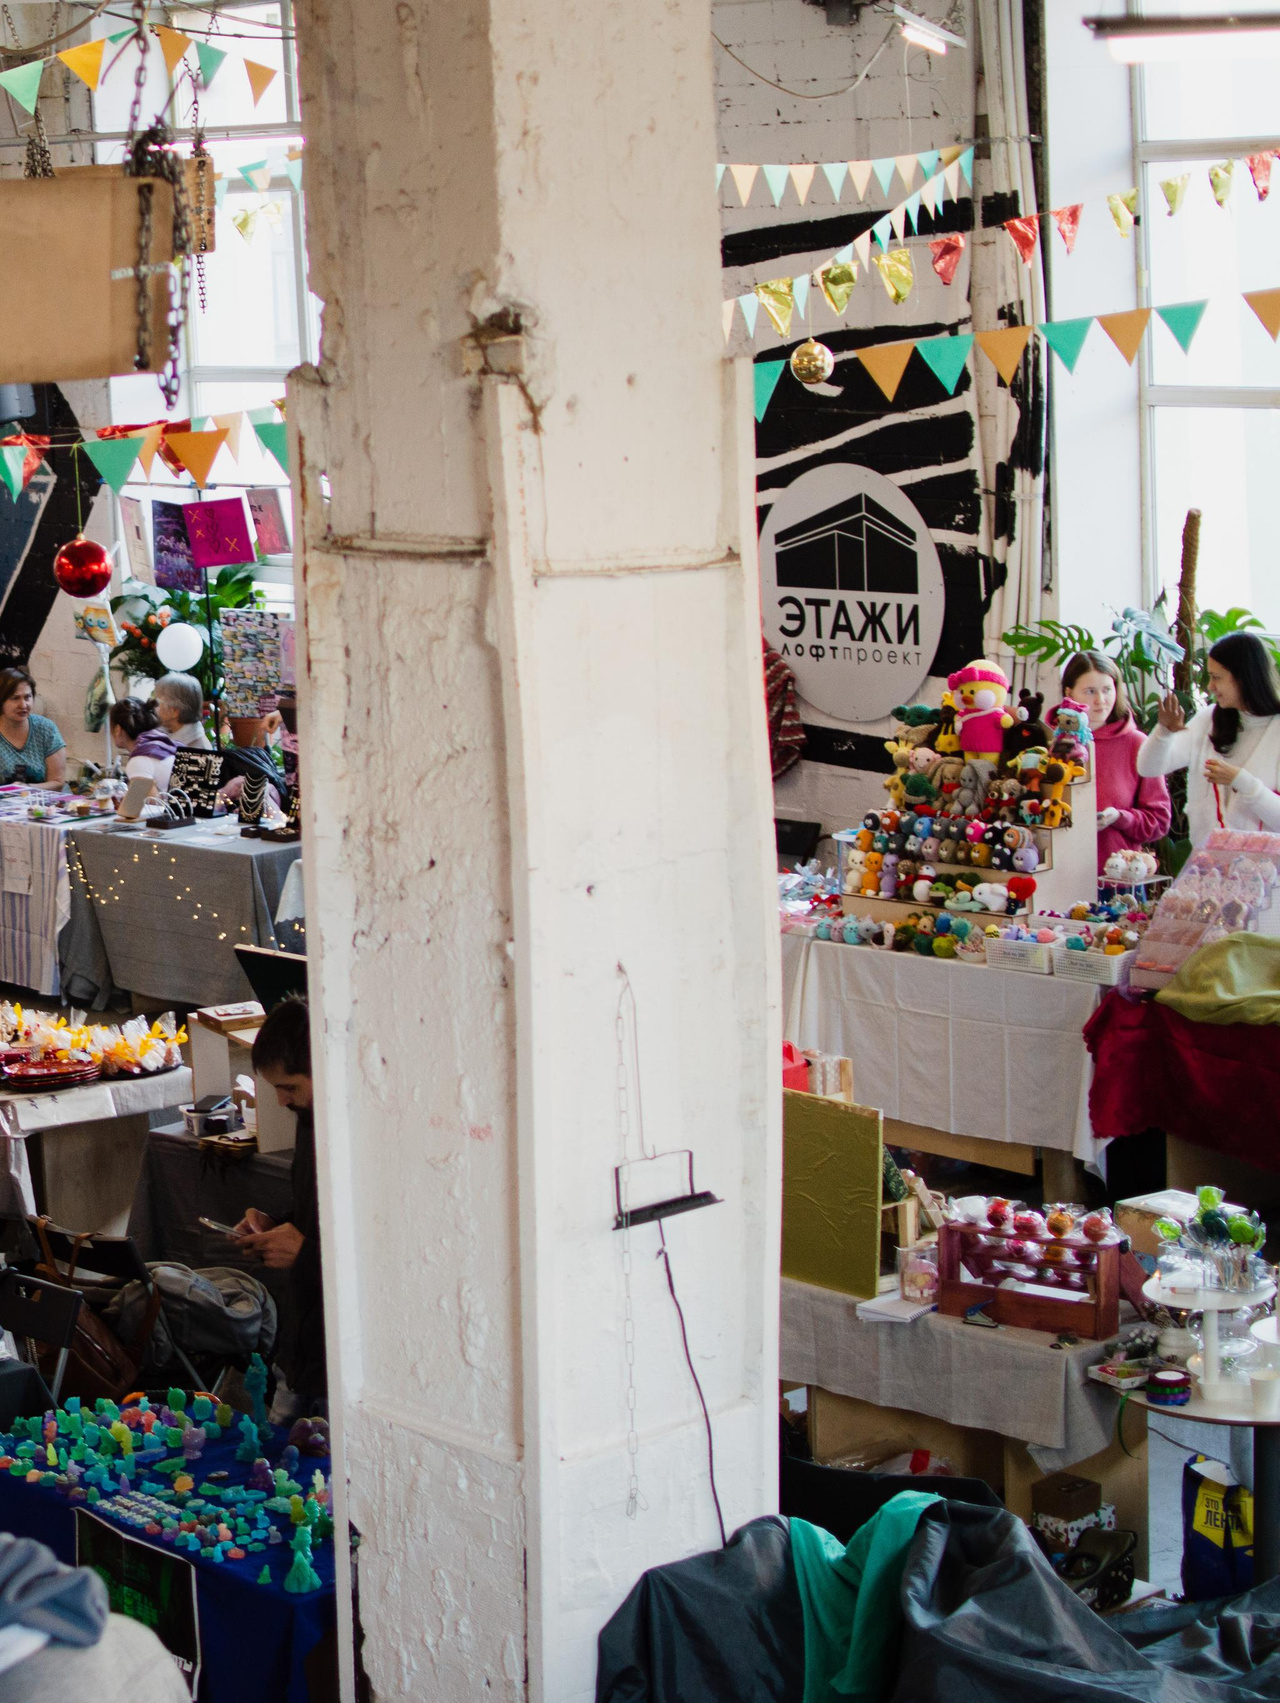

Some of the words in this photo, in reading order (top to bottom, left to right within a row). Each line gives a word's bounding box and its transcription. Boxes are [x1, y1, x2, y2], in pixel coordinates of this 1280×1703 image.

[778, 596, 920, 646] ЭТАЖИ
[1204, 1497, 1220, 1511] ЭТО
[1204, 1509, 1245, 1532] ЛЕНТА
